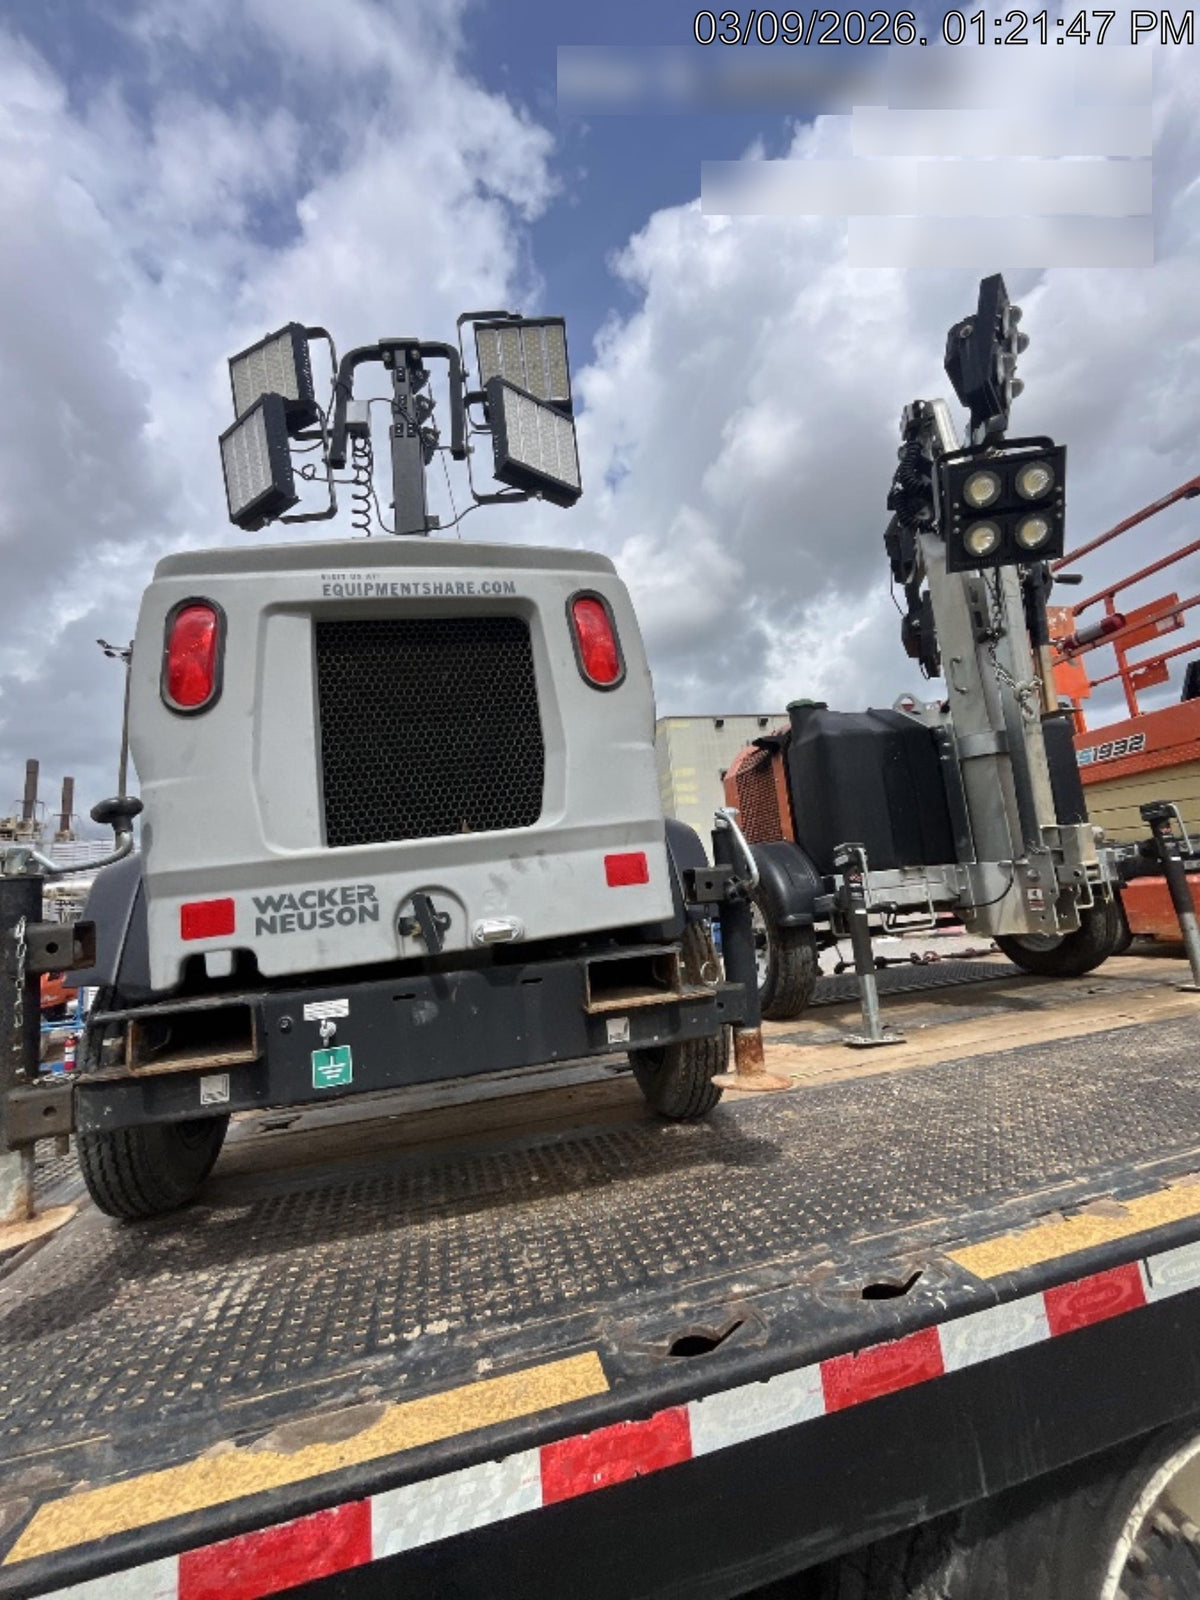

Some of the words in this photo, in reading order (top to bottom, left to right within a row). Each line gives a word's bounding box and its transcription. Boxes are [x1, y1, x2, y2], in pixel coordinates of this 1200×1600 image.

[322, 581, 516, 598] EQUIPMENTSHARE.COM
[252, 884, 379, 915] WACKER
[255, 903, 380, 936] NEUSON
